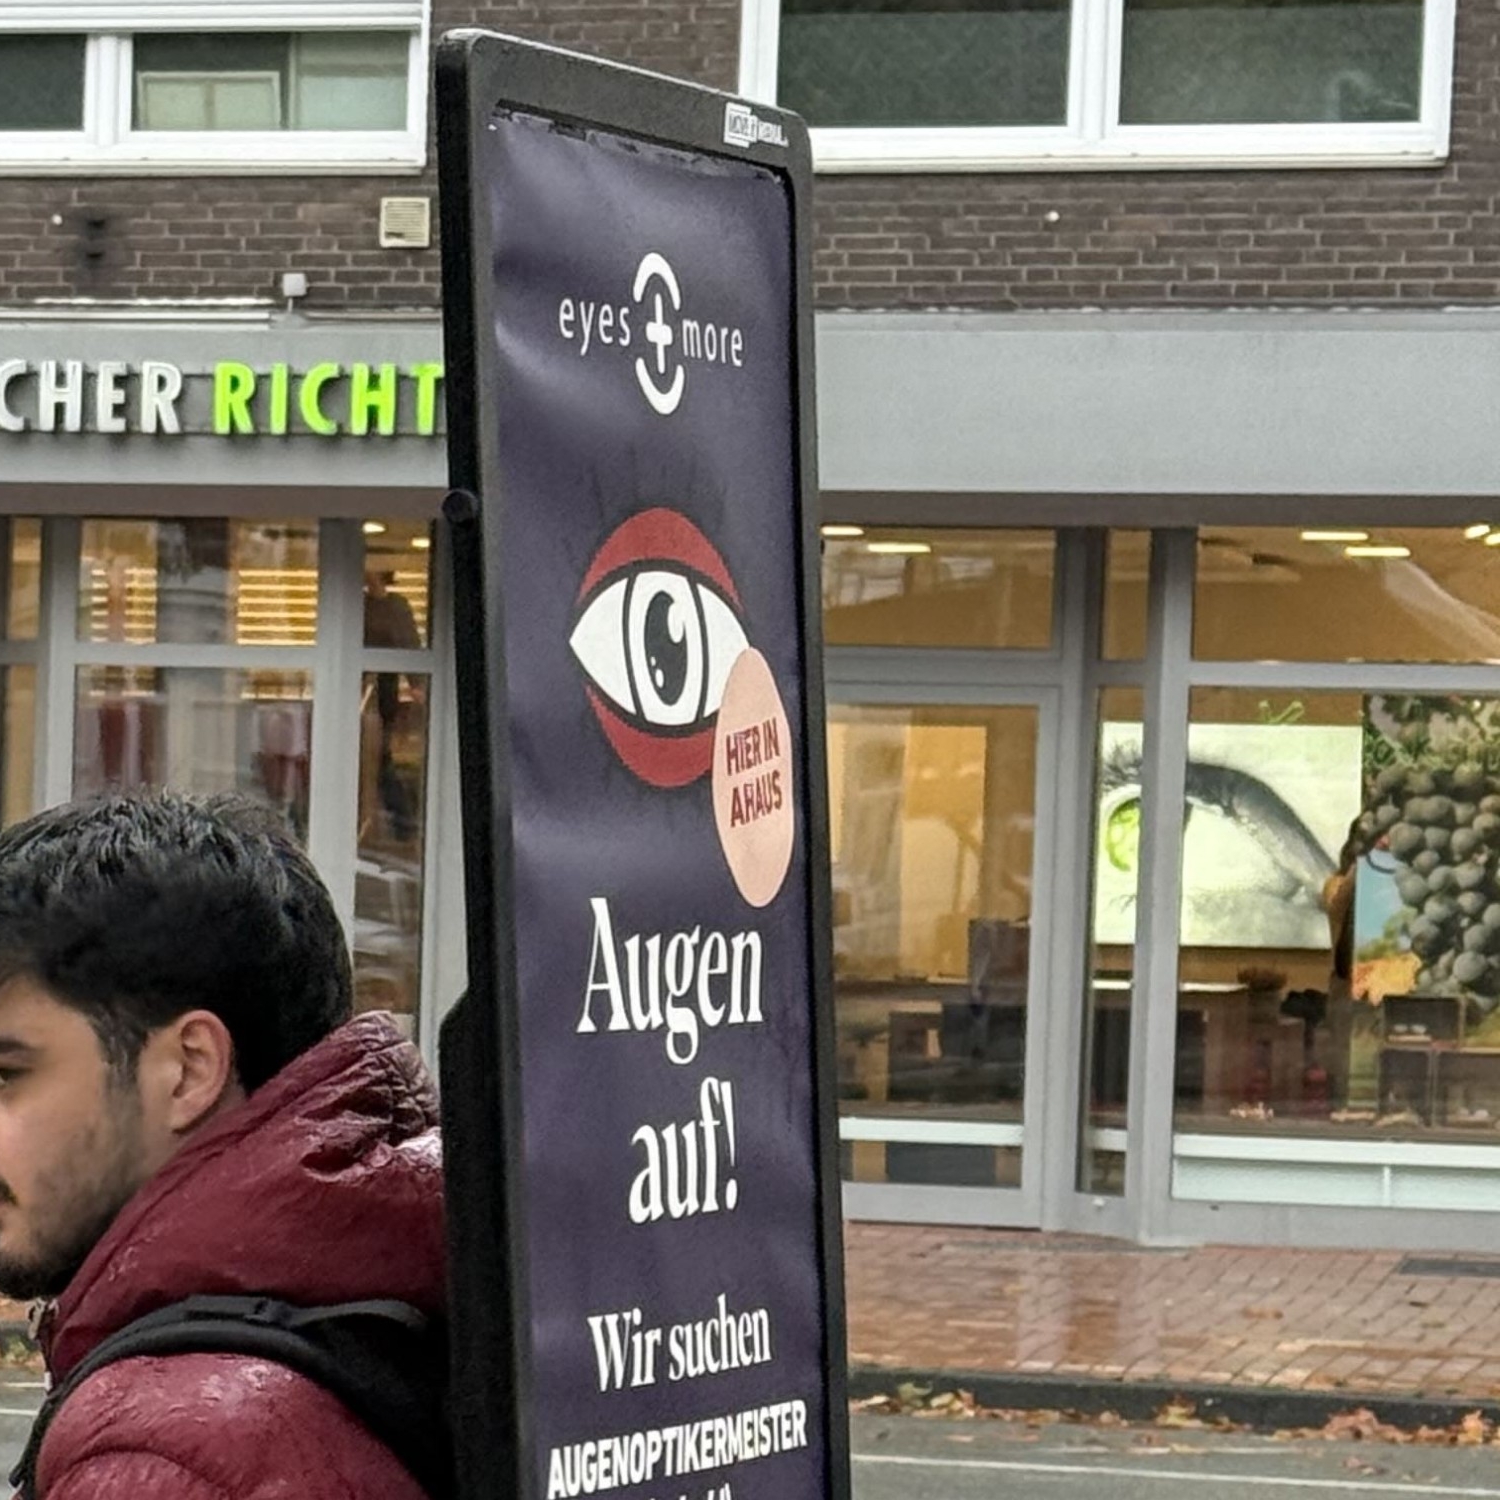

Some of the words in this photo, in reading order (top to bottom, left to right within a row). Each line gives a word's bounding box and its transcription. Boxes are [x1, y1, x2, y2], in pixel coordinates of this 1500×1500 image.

[558, 298, 631, 356] eyes
[682, 318, 743, 367] more
[726, 724, 762, 776] HIER
[762, 716, 780, 762] IN
[730, 769, 783, 828] AHAUS
[576, 897, 763, 1065] Augen
[629, 1076, 738, 1224] auf!
[587, 1307, 662, 1392] Wir
[668, 1293, 772, 1381] suchen
[548, 1399, 807, 1500] AUGENOPTIKERMEISTER
